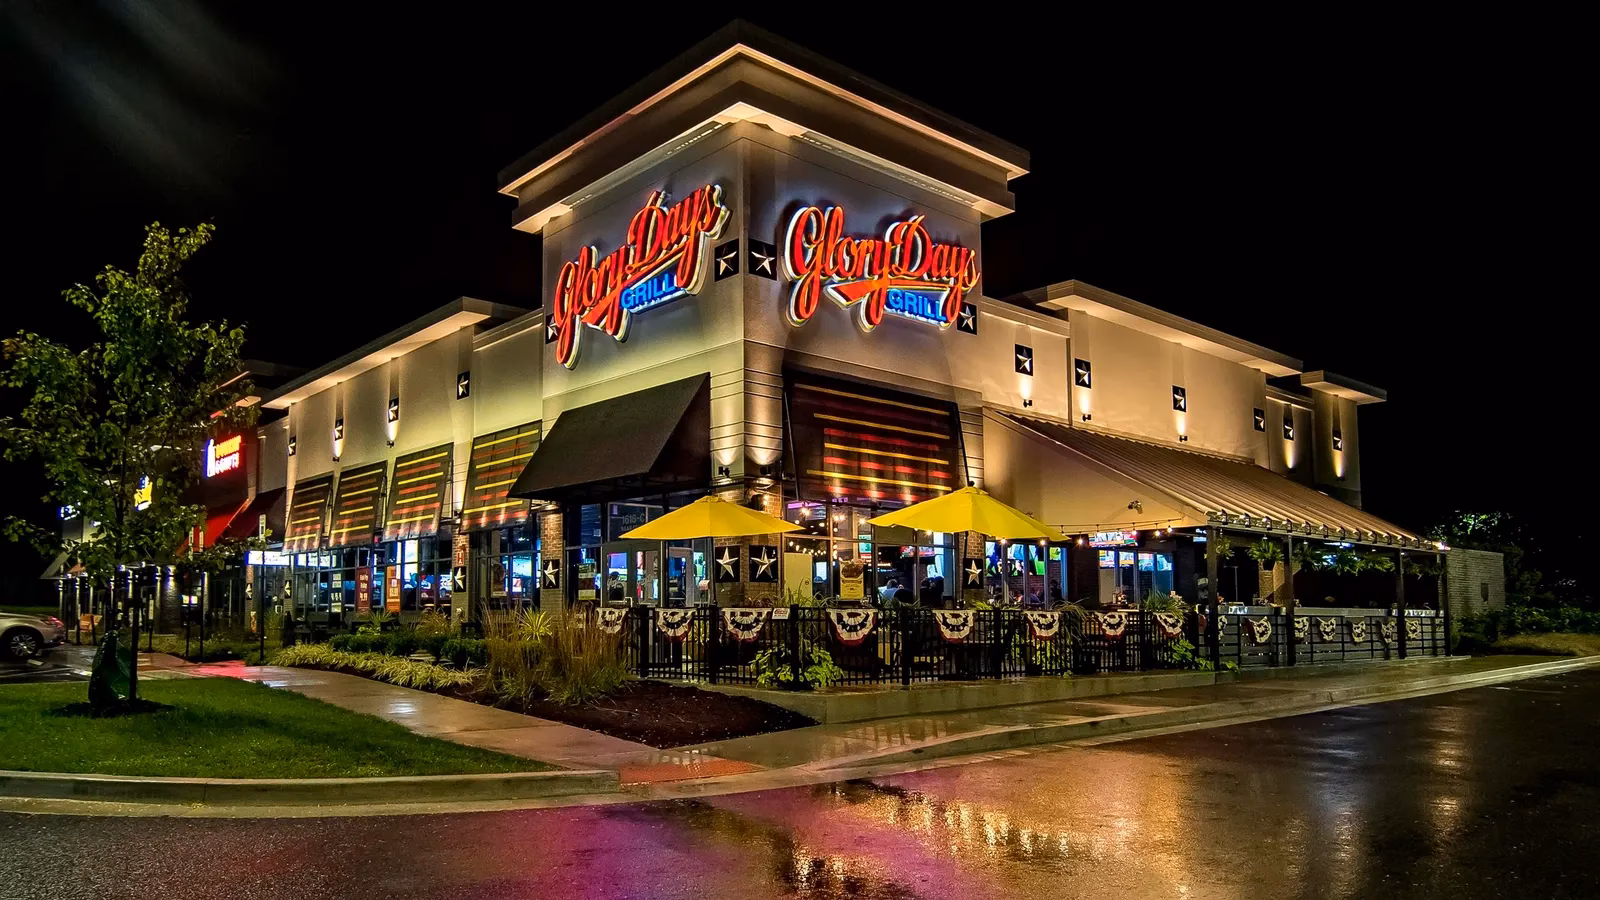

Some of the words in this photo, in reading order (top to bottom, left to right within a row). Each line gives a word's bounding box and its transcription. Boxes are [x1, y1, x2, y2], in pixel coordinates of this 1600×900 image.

[554, 245, 629, 366] Glory
[625, 184, 722, 289] Days
[621, 272, 676, 310] GRILL
[788, 206, 892, 326] Glory
[890, 215, 980, 325] Days
[888, 287, 947, 322] GRILL
